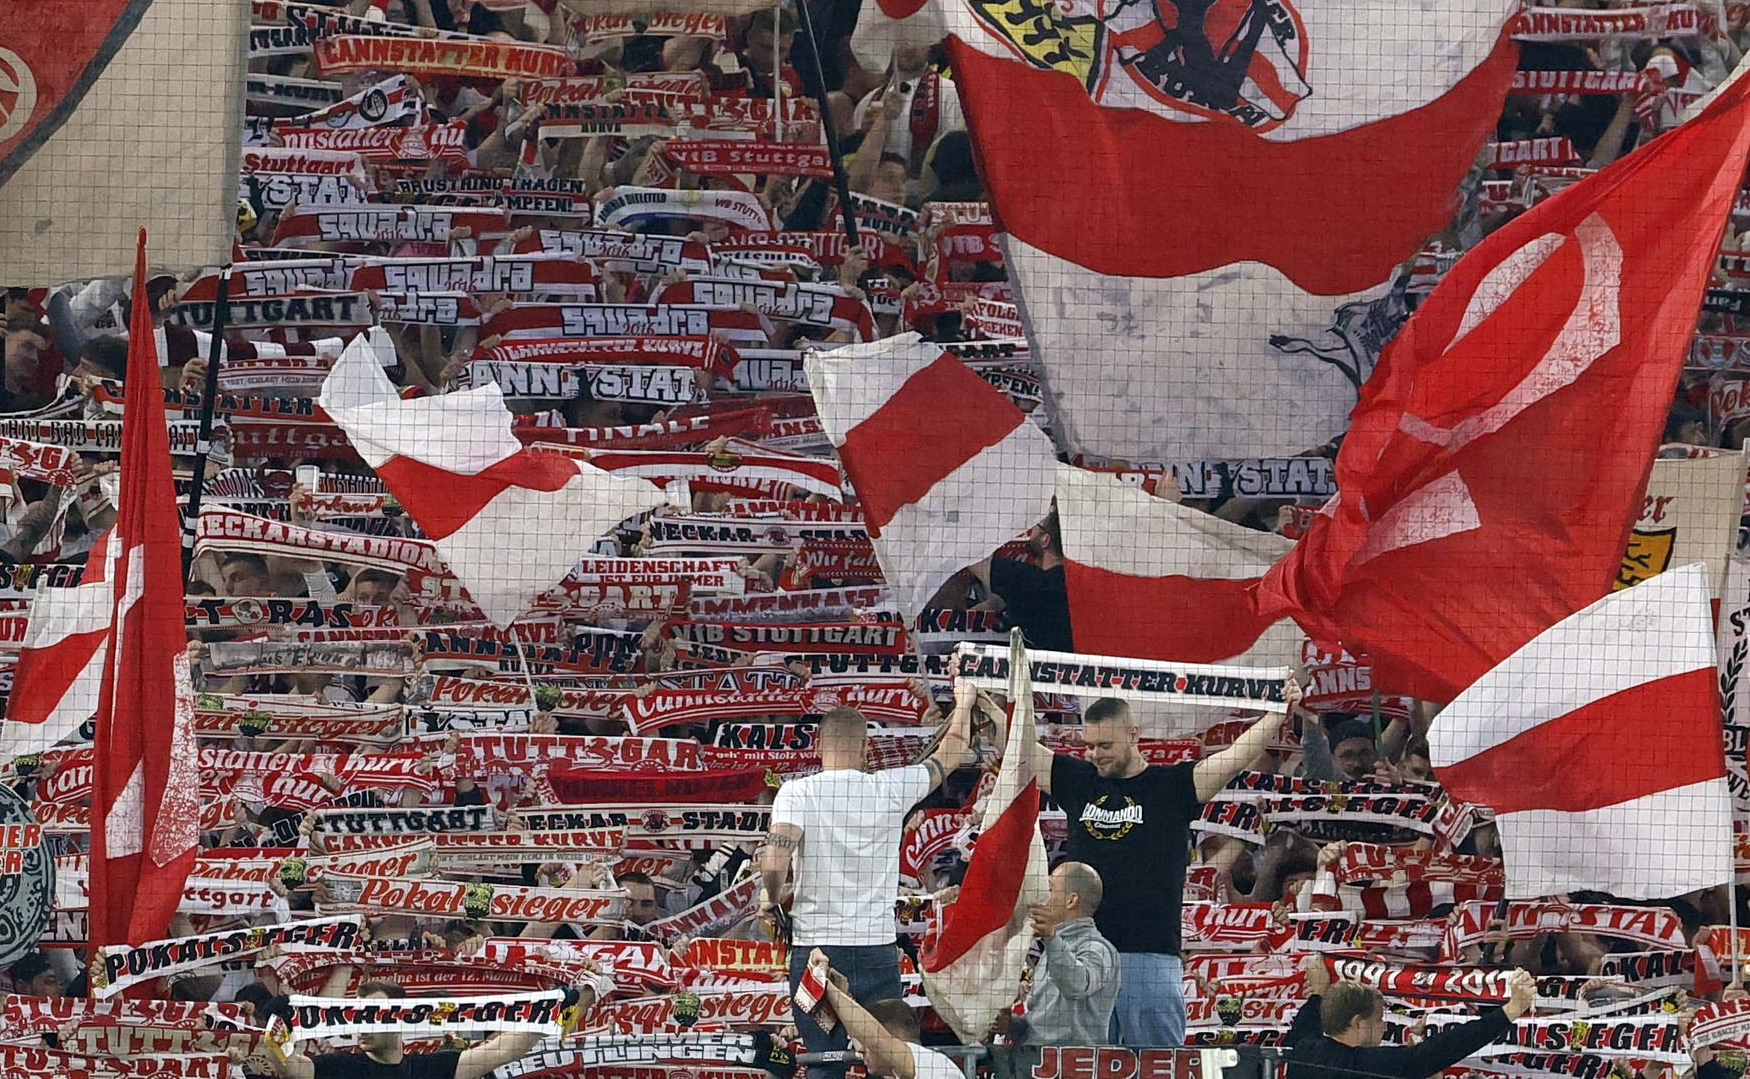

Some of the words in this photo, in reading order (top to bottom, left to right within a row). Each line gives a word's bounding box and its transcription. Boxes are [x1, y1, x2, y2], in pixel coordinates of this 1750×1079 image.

[325, 37, 499, 68] CANNSTATTER
[728, 151, 832, 169] Stuttgar
[318, 208, 453, 241] squadra
[384, 257, 534, 293] squadra
[561, 307, 709, 338] squadra
[800, 527, 867, 543] STAD
[673, 624, 722, 643] VfB
[731, 624, 904, 649] STUTTGART
[784, 653, 947, 674] STUTTGA
[958, 653, 1177, 693] CANNSTATTER
[1184, 672, 1284, 701] KURVE
[628, 688, 815, 720] Cannstatter
[326, 807, 488, 833] TUTTGART
[684, 812, 771, 830] STADI
[1079, 804, 1145, 825] COMMANDO
[359, 877, 466, 914] Pokal
[487, 887, 611, 921] sieger
[1333, 958, 1399, 990] 1997
